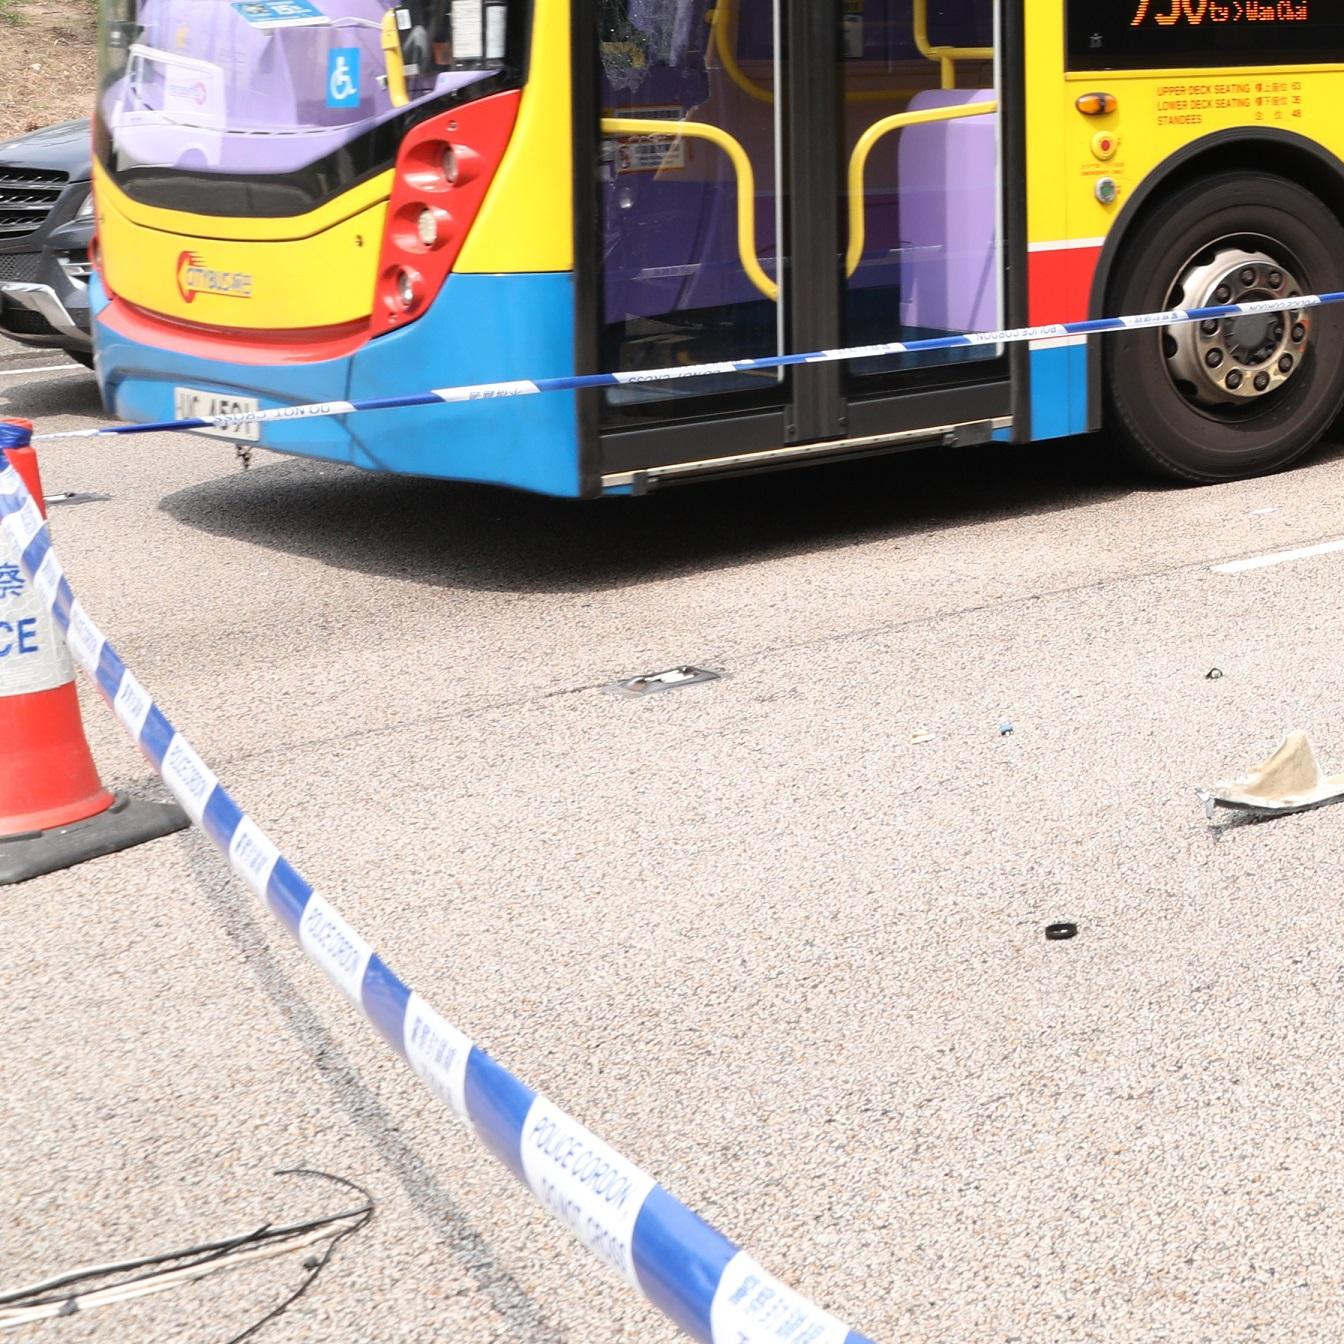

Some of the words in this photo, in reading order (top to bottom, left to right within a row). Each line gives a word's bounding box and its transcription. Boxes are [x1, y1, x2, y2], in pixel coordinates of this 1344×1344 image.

[1156, 86, 1186, 97] UPPER
[1188, 85, 1212, 96] DECK
[1214, 83, 1250, 95] SEATING
[1157, 100, 1187, 111] LOWER
[1190, 99, 1212, 110] DECK
[1214, 97, 1250, 109] SEATING
[1157, 114, 1202, 126] STANDEES
[274, 408, 305, 418] NOT
[309, 405, 330, 414] DO
[213, 412, 267, 426] CROSS
[530, 1116, 583, 1169] POLICE
[572, 1143, 634, 1210] CORDON
